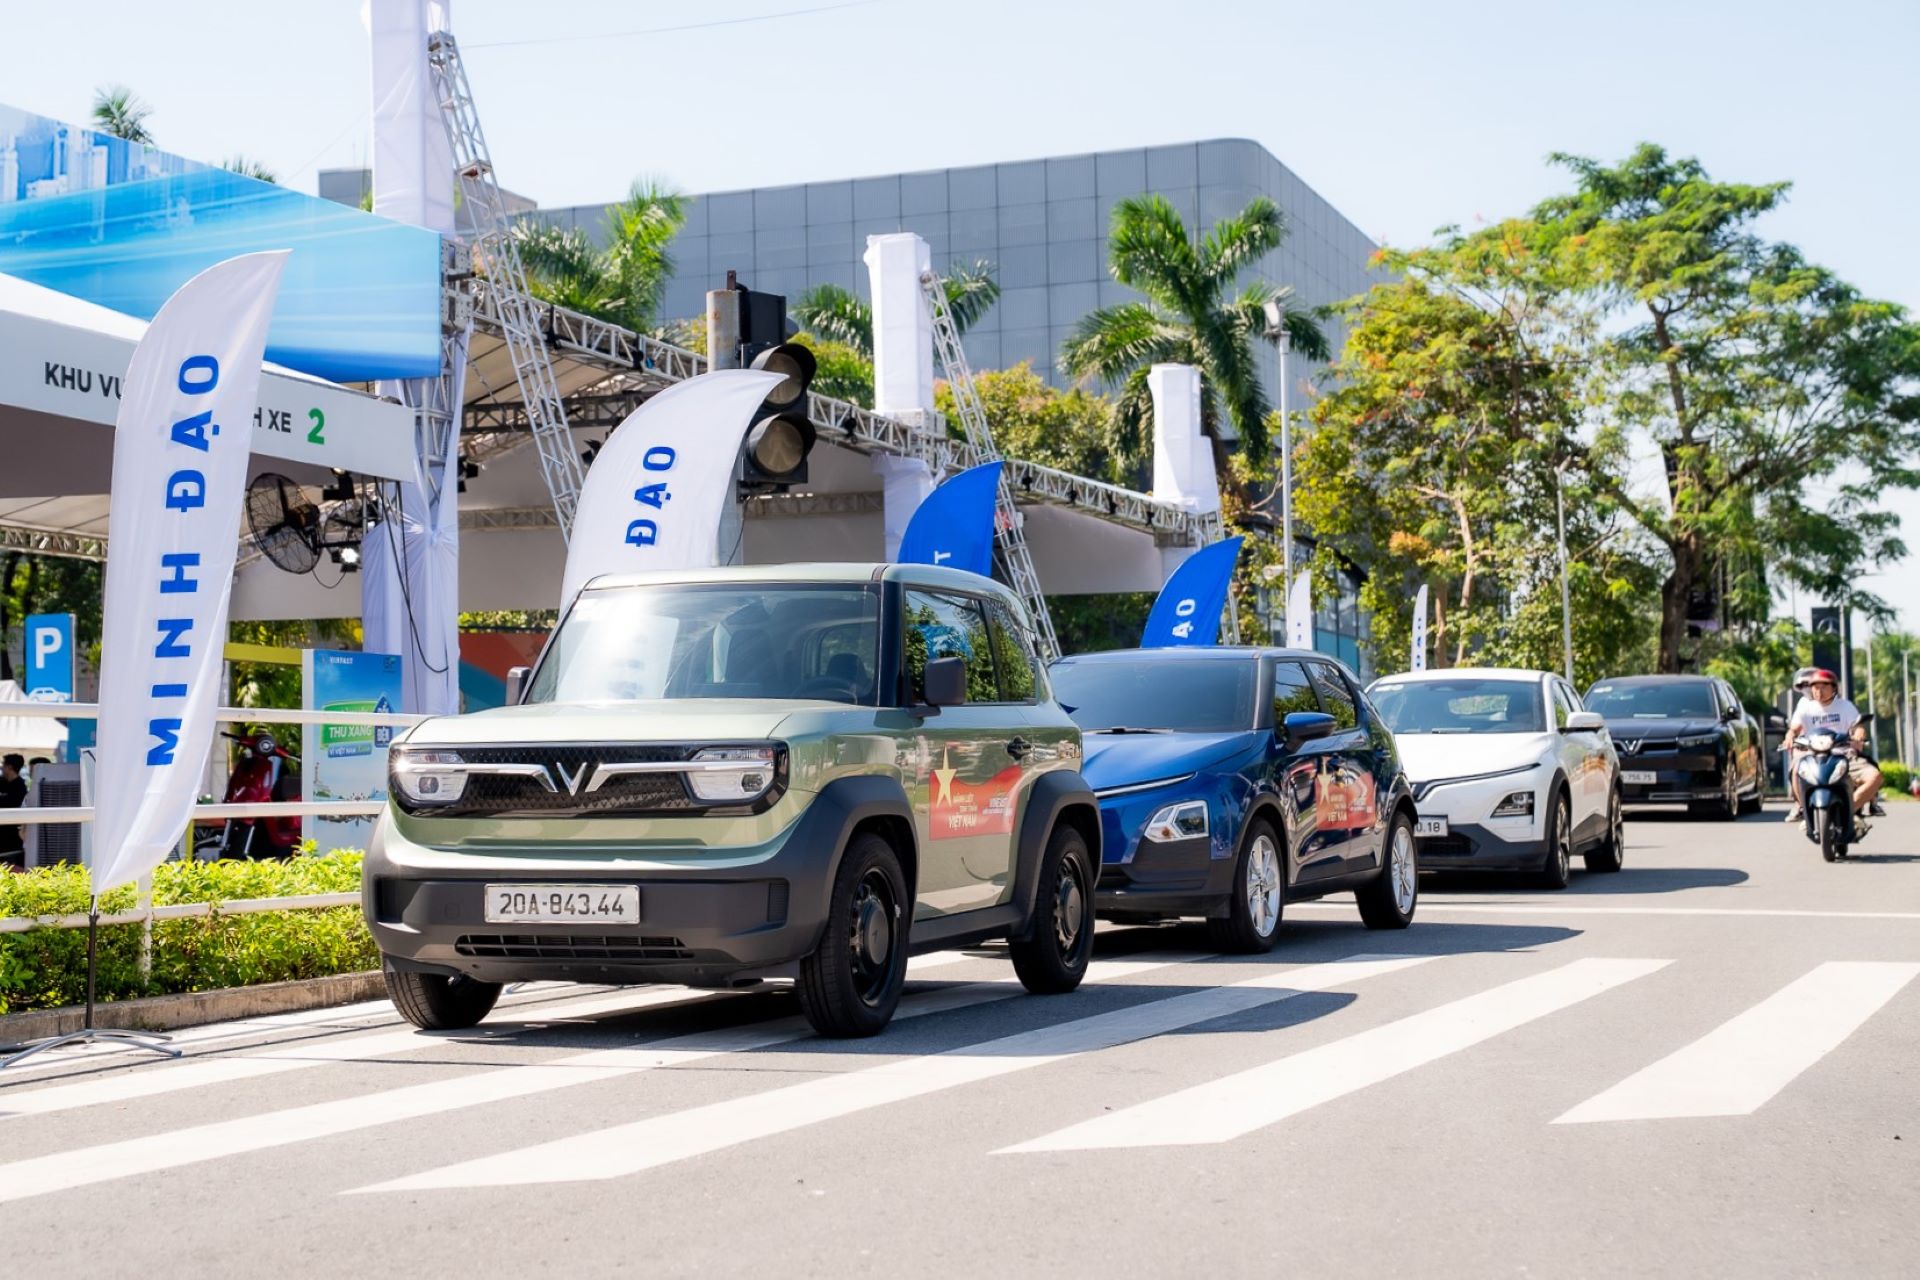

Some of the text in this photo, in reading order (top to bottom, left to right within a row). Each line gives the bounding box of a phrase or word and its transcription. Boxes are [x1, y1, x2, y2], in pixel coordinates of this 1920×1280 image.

[45, 361, 92, 393] KHU
[267, 408, 292, 434] XE
[307, 407, 325, 446] 2
[625, 446, 676, 548] ĐẠO
[146, 354, 220, 766] MINH ĐẠO
[35, 627, 62, 669] P
[1416, 821, 1441, 832] 0.18
[499, 893, 624, 915] 20A-843.44
